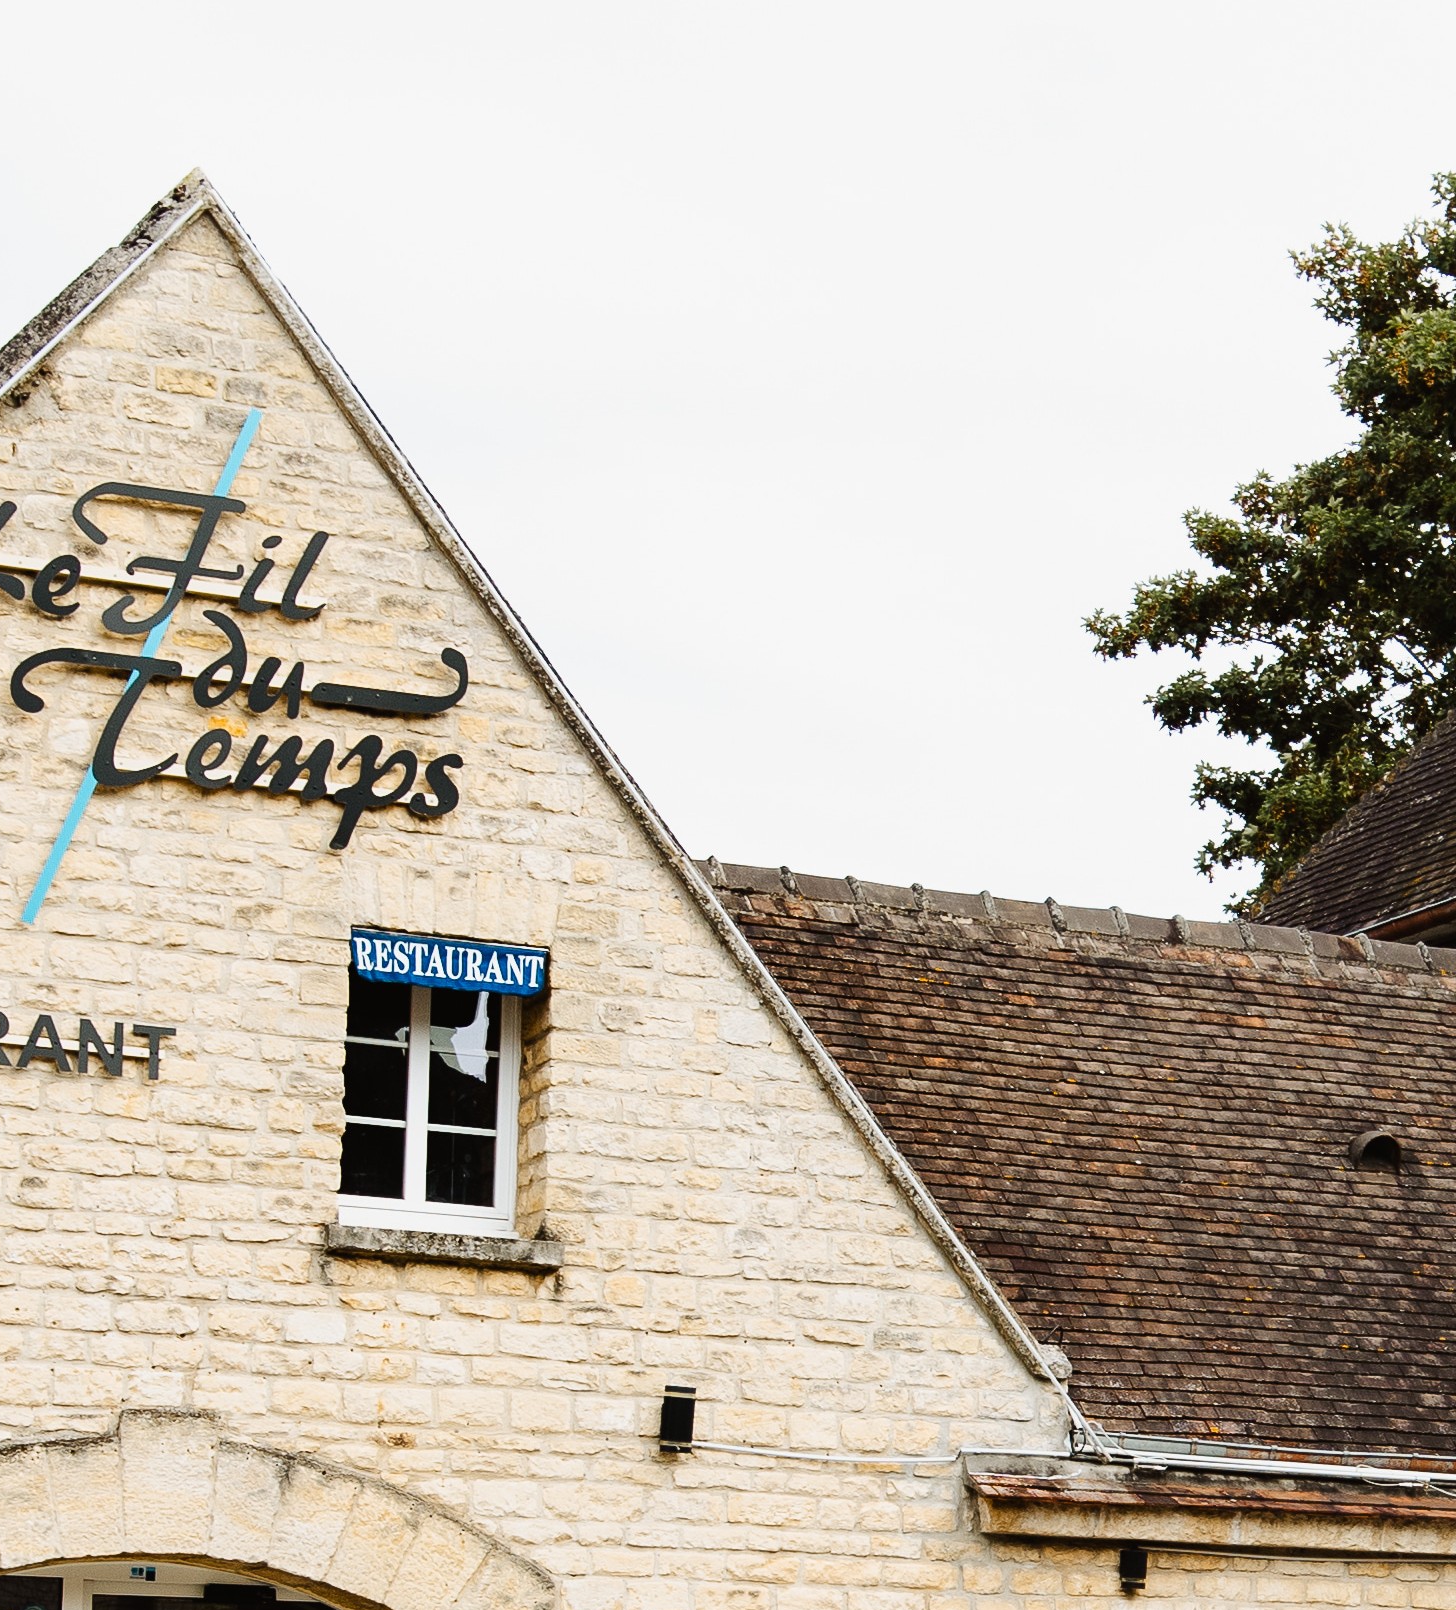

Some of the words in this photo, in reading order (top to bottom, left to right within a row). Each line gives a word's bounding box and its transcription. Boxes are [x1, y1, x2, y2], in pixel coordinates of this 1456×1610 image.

[72, 482, 330, 635] Fil
[193, 610, 469, 719] du
[10, 647, 464, 849] Temps
[352, 936, 544, 988] RESTAURANT
